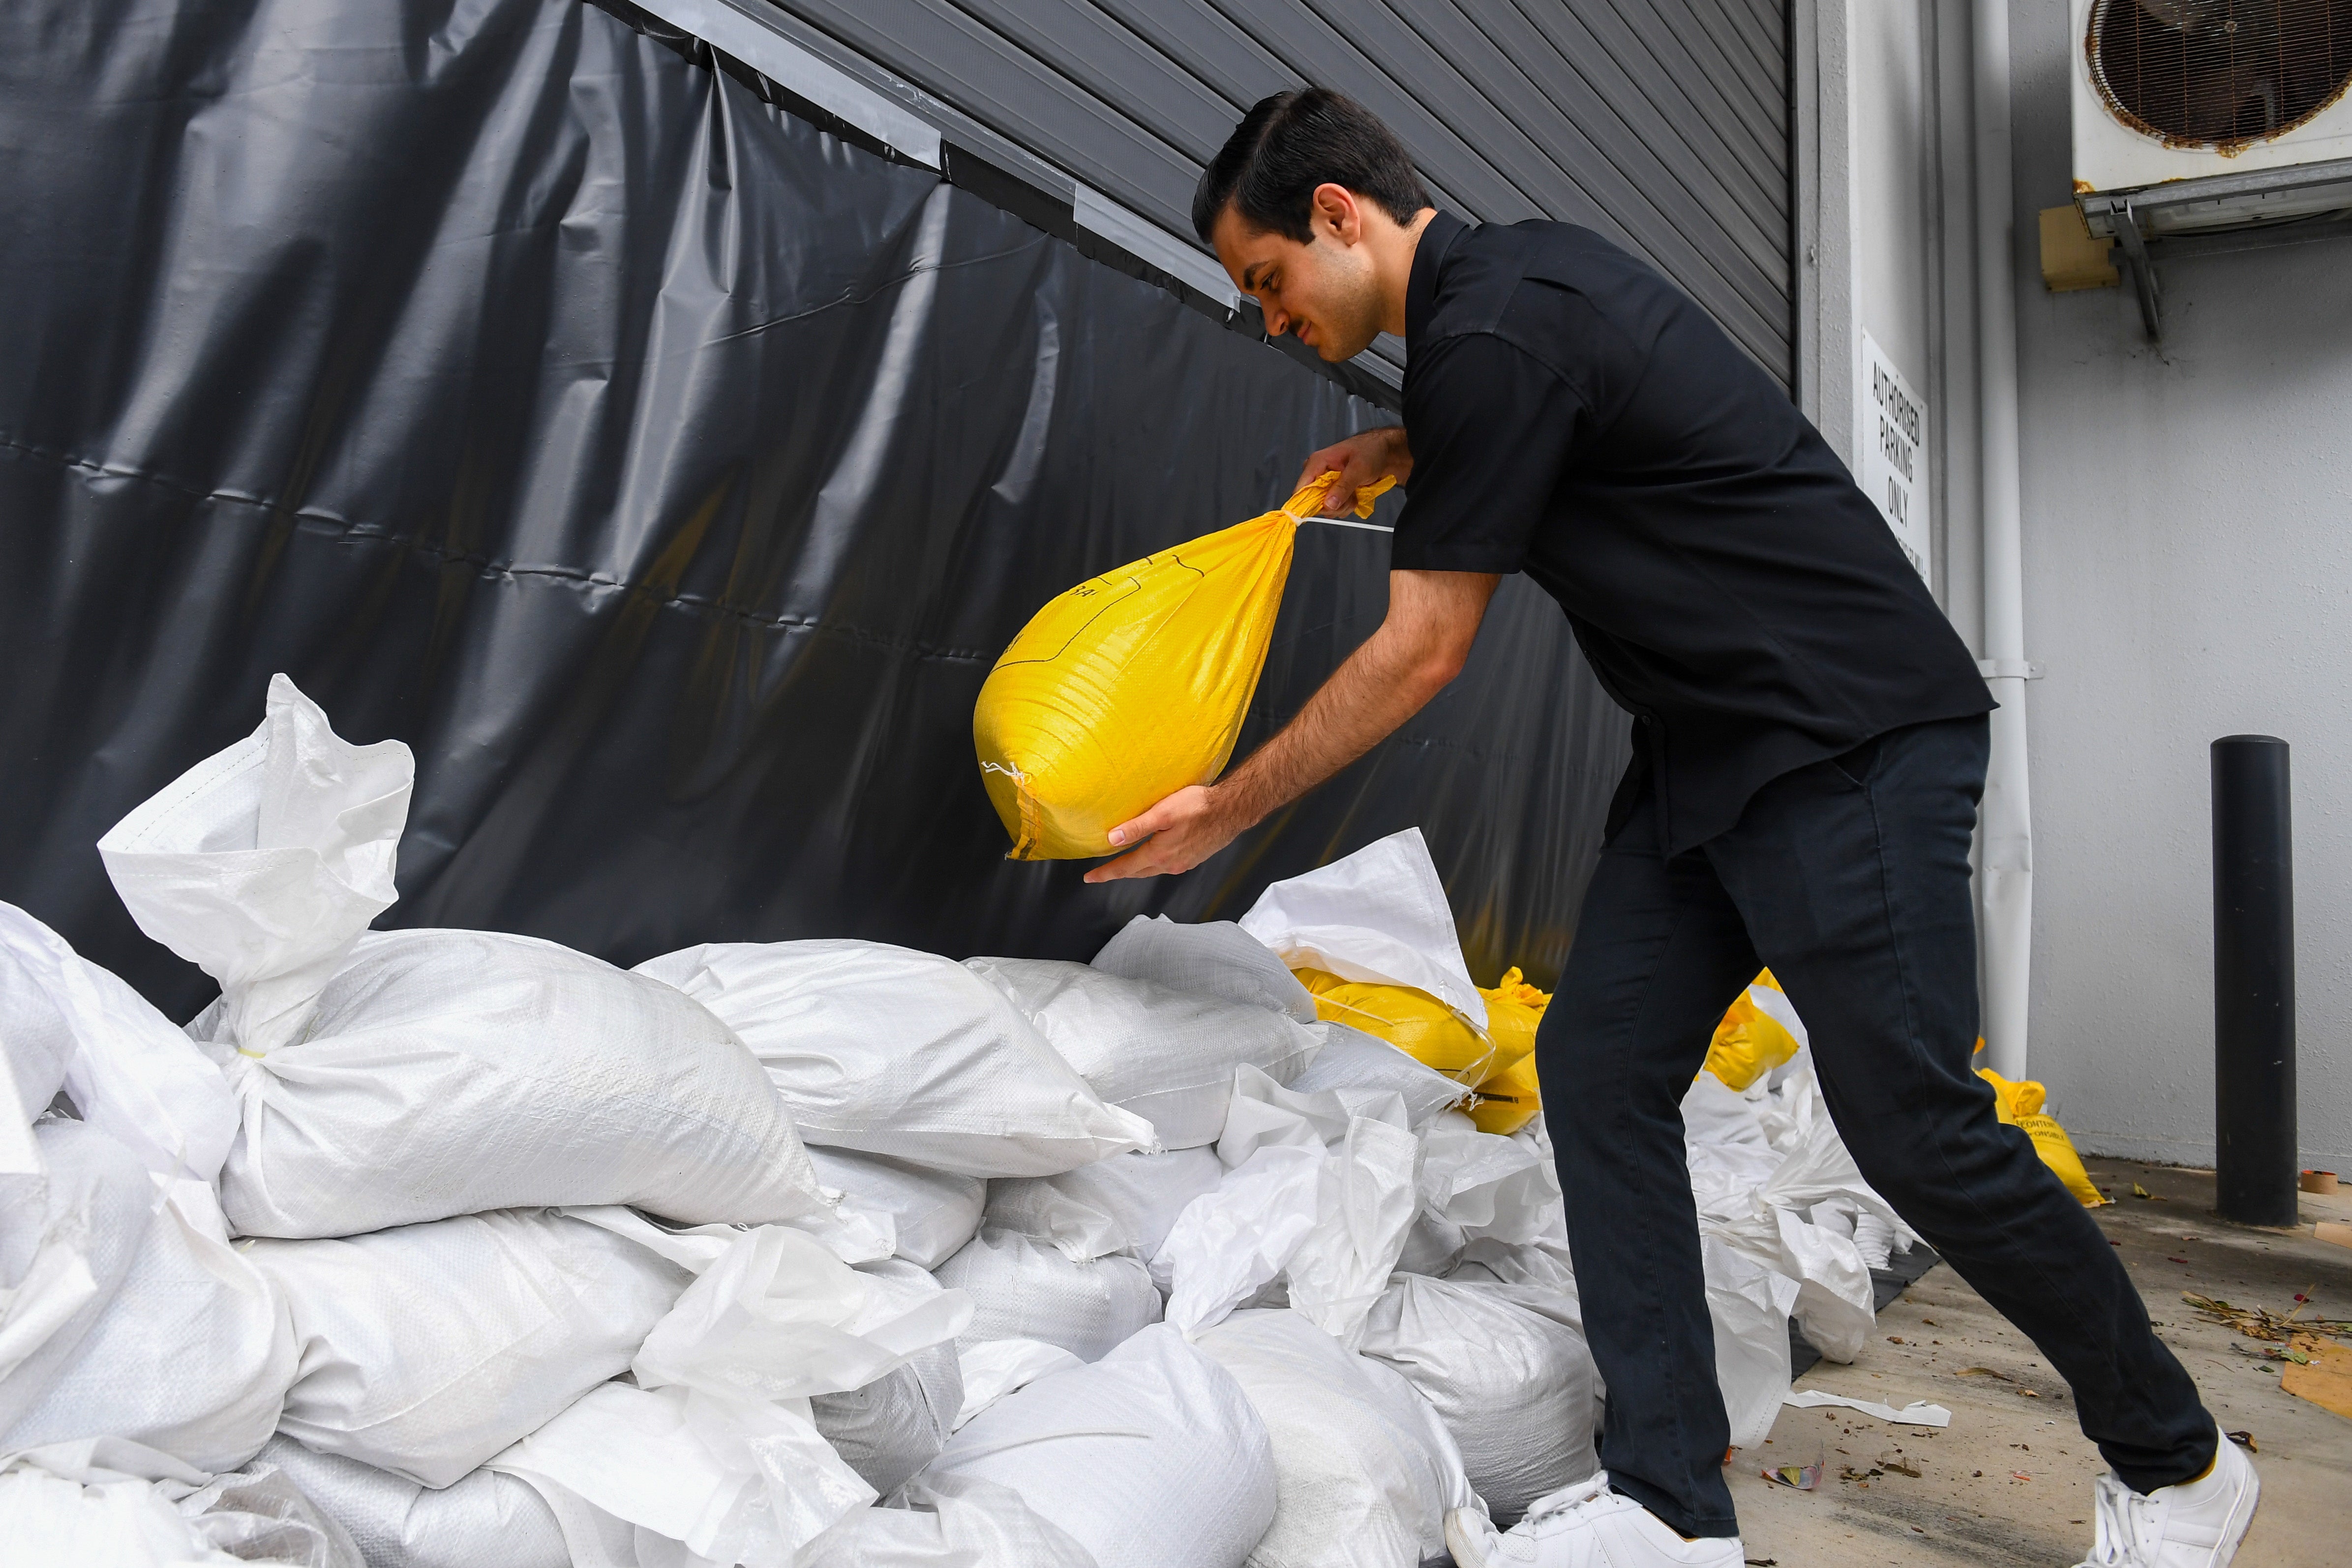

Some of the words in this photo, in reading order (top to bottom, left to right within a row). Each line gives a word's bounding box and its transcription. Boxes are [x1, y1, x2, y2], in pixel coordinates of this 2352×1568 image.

[1873, 361, 1919, 447] AUTHORISED
[1880, 414, 1912, 484] PARKING
[1888, 475, 1908, 528] ONLY
